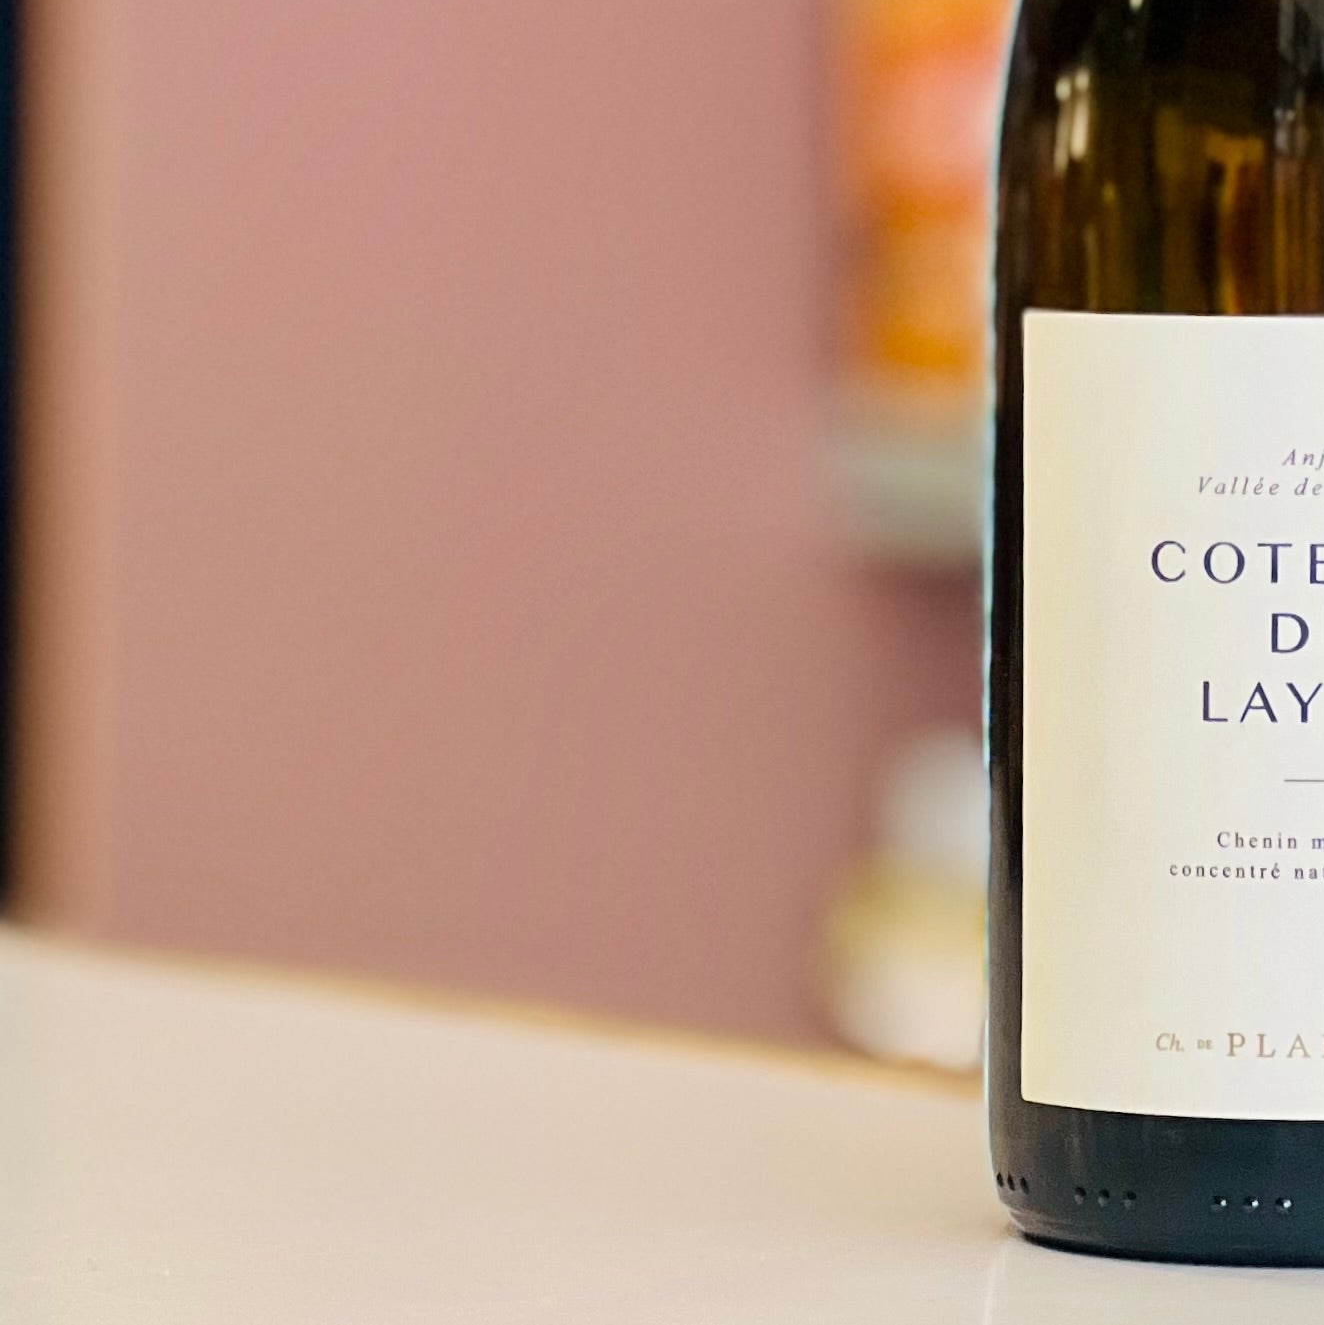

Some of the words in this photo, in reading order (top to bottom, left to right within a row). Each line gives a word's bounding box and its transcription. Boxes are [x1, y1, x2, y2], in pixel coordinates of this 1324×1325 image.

[1197, 476, 1280, 497] Vallée
[1294, 477, 1324, 497] de
[1216, 832, 1298, 850] Chenin
[1169, 863, 1281, 880] concentré
[1155, 1033, 1185, 1053] Ch.
[1197, 1040, 1213, 1050] DE
